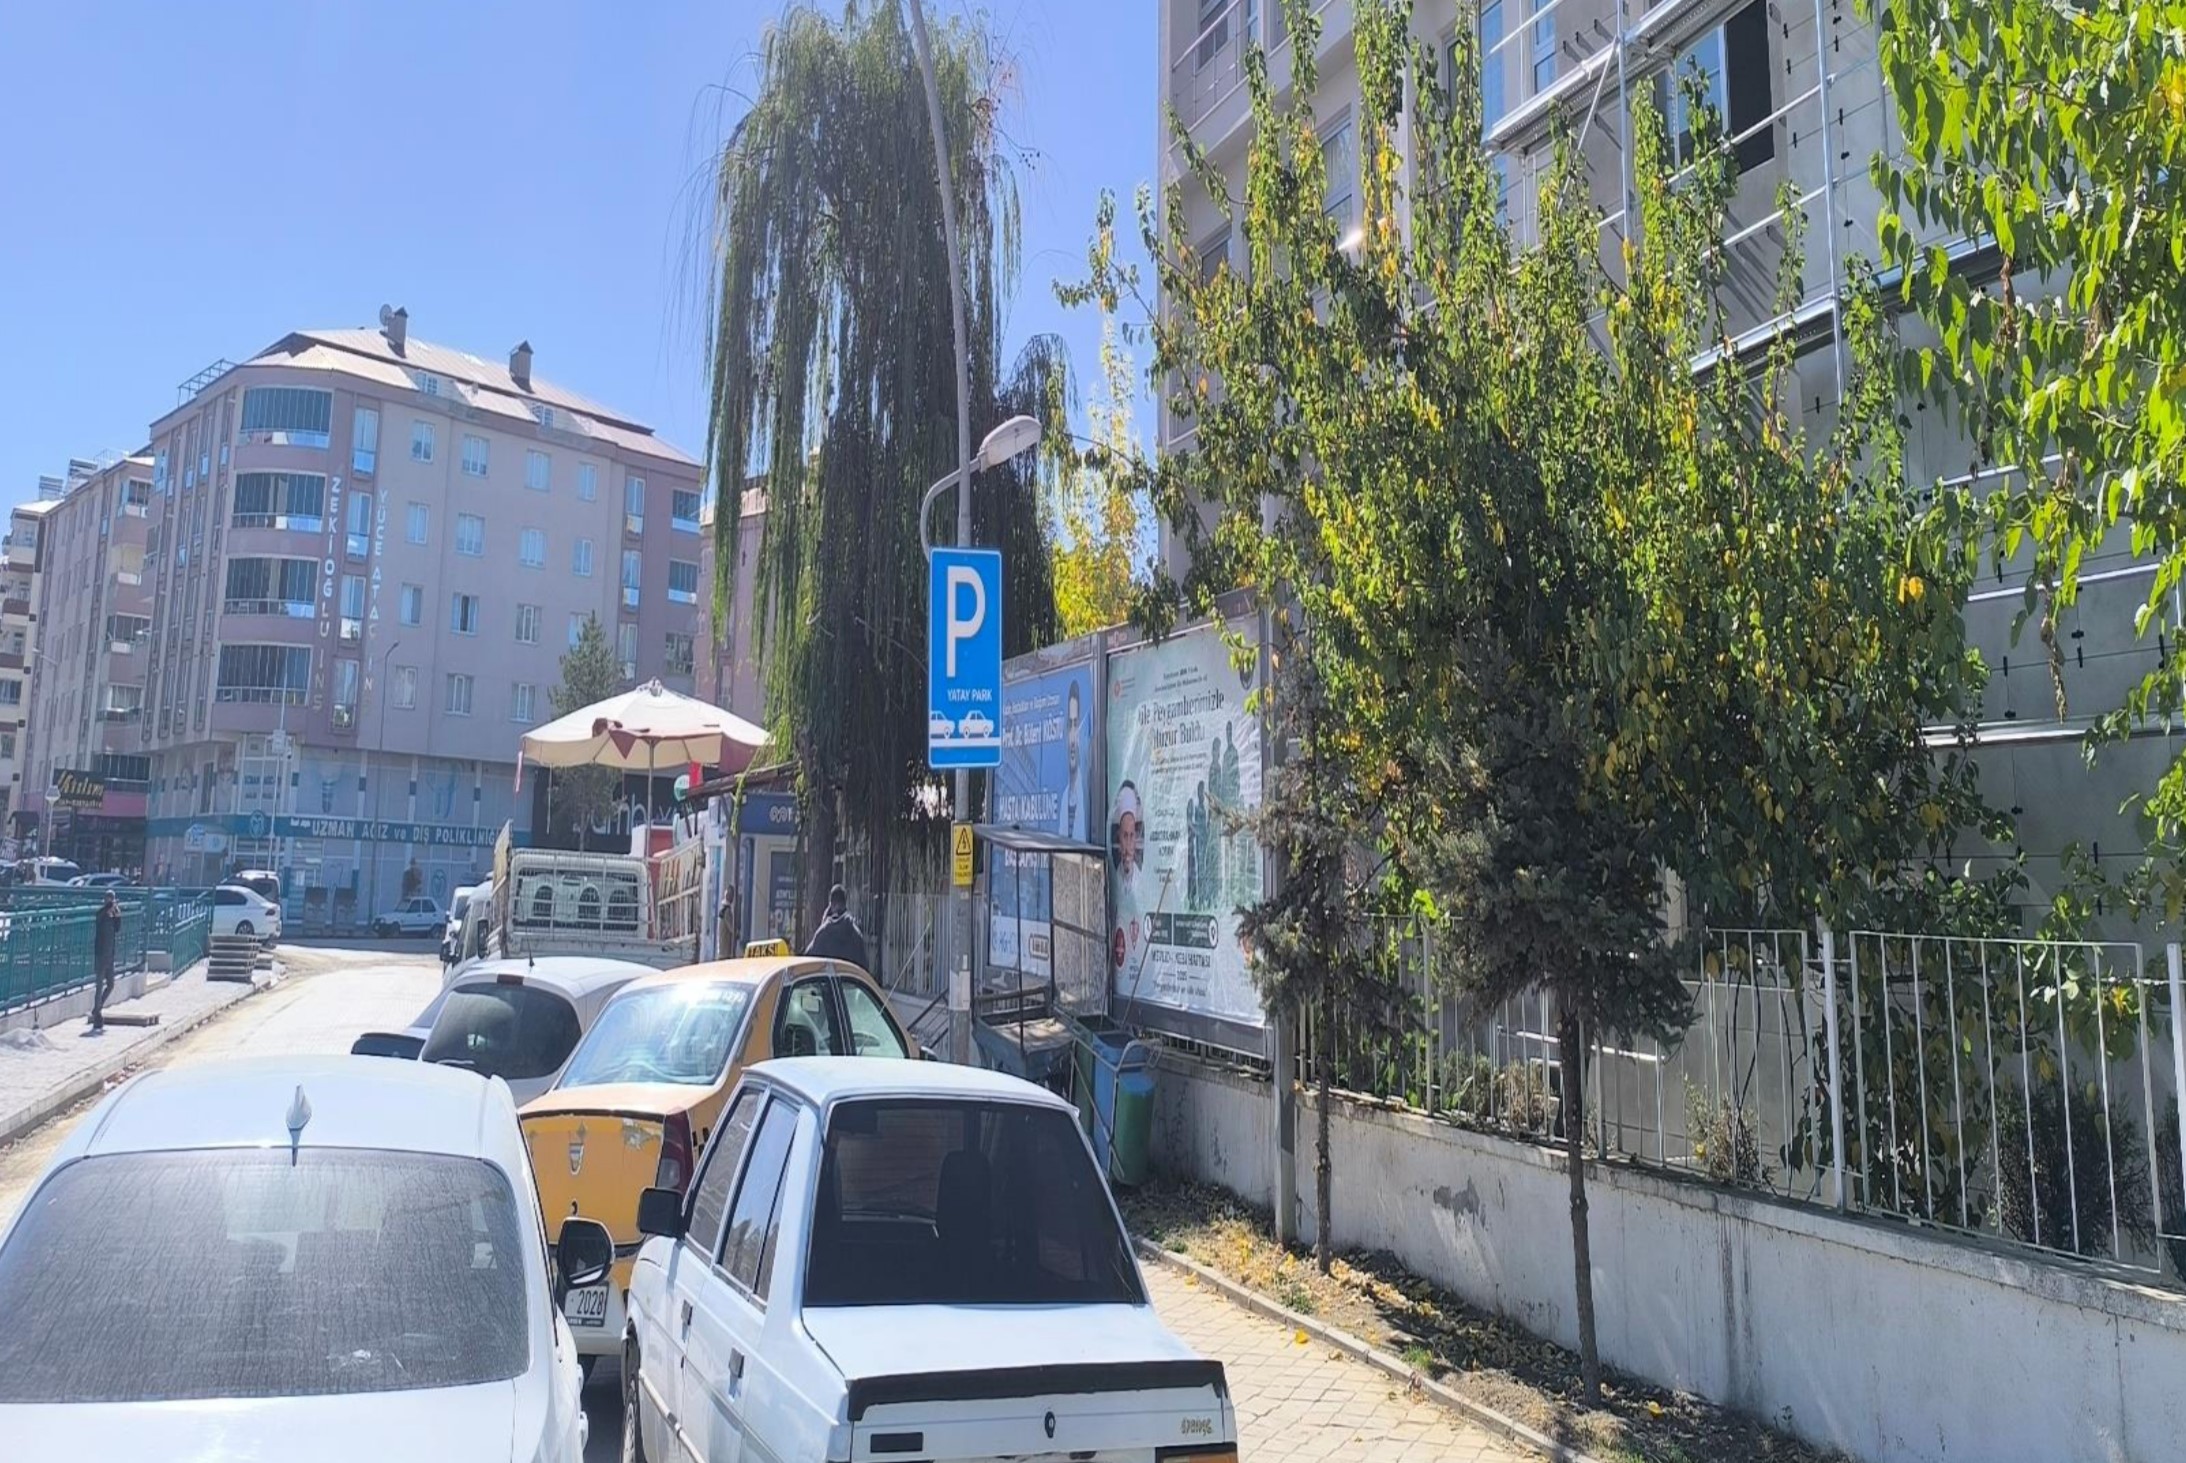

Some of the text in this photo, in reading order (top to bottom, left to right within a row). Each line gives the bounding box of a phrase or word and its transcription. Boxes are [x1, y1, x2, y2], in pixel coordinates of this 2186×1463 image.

[946, 565, 986, 678] P
[946, 688, 993, 702] YATAY PARK
[312, 820, 355, 838] UZMAN
[577, 1290, 604, 1315] 2028
